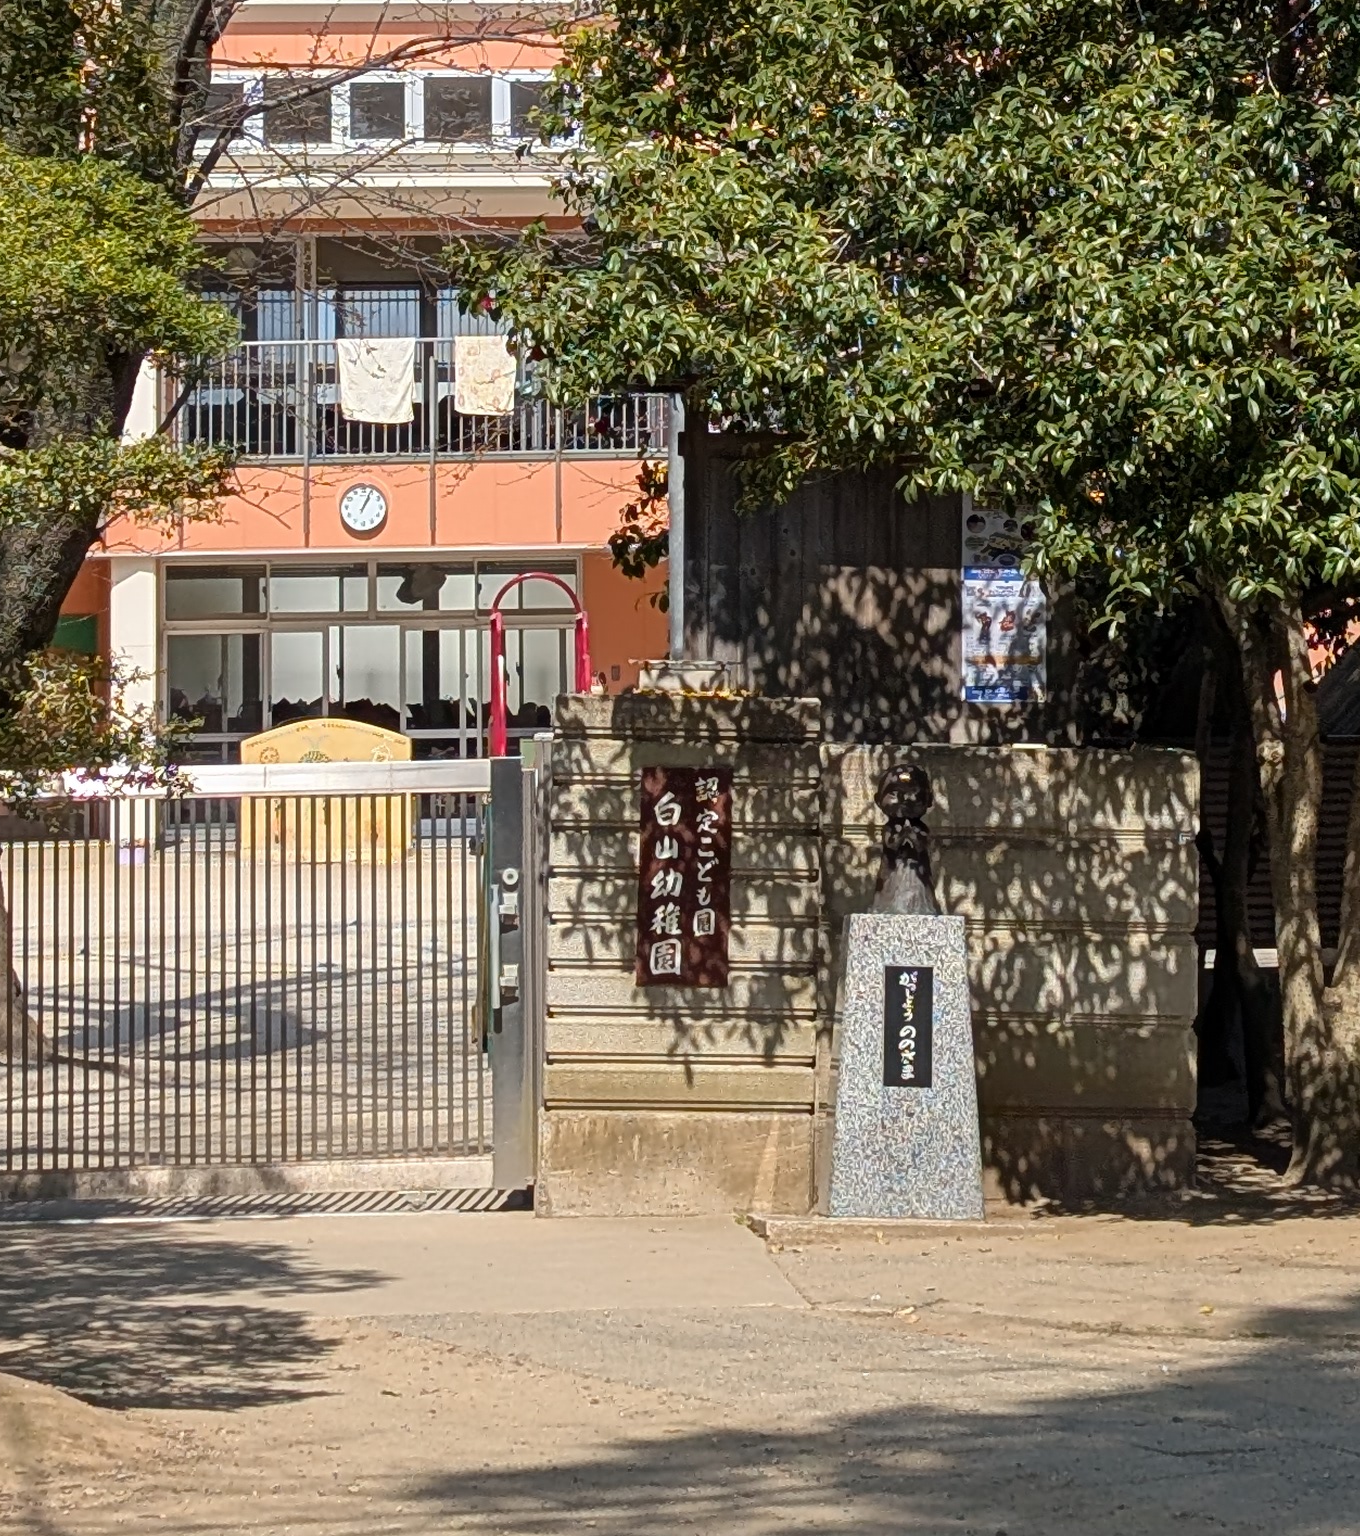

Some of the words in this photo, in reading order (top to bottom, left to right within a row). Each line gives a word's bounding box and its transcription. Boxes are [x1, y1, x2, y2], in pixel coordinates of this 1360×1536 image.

[650, 791, 684, 976] 白山幼稚園
[693, 776, 720, 937] 認定こども園
